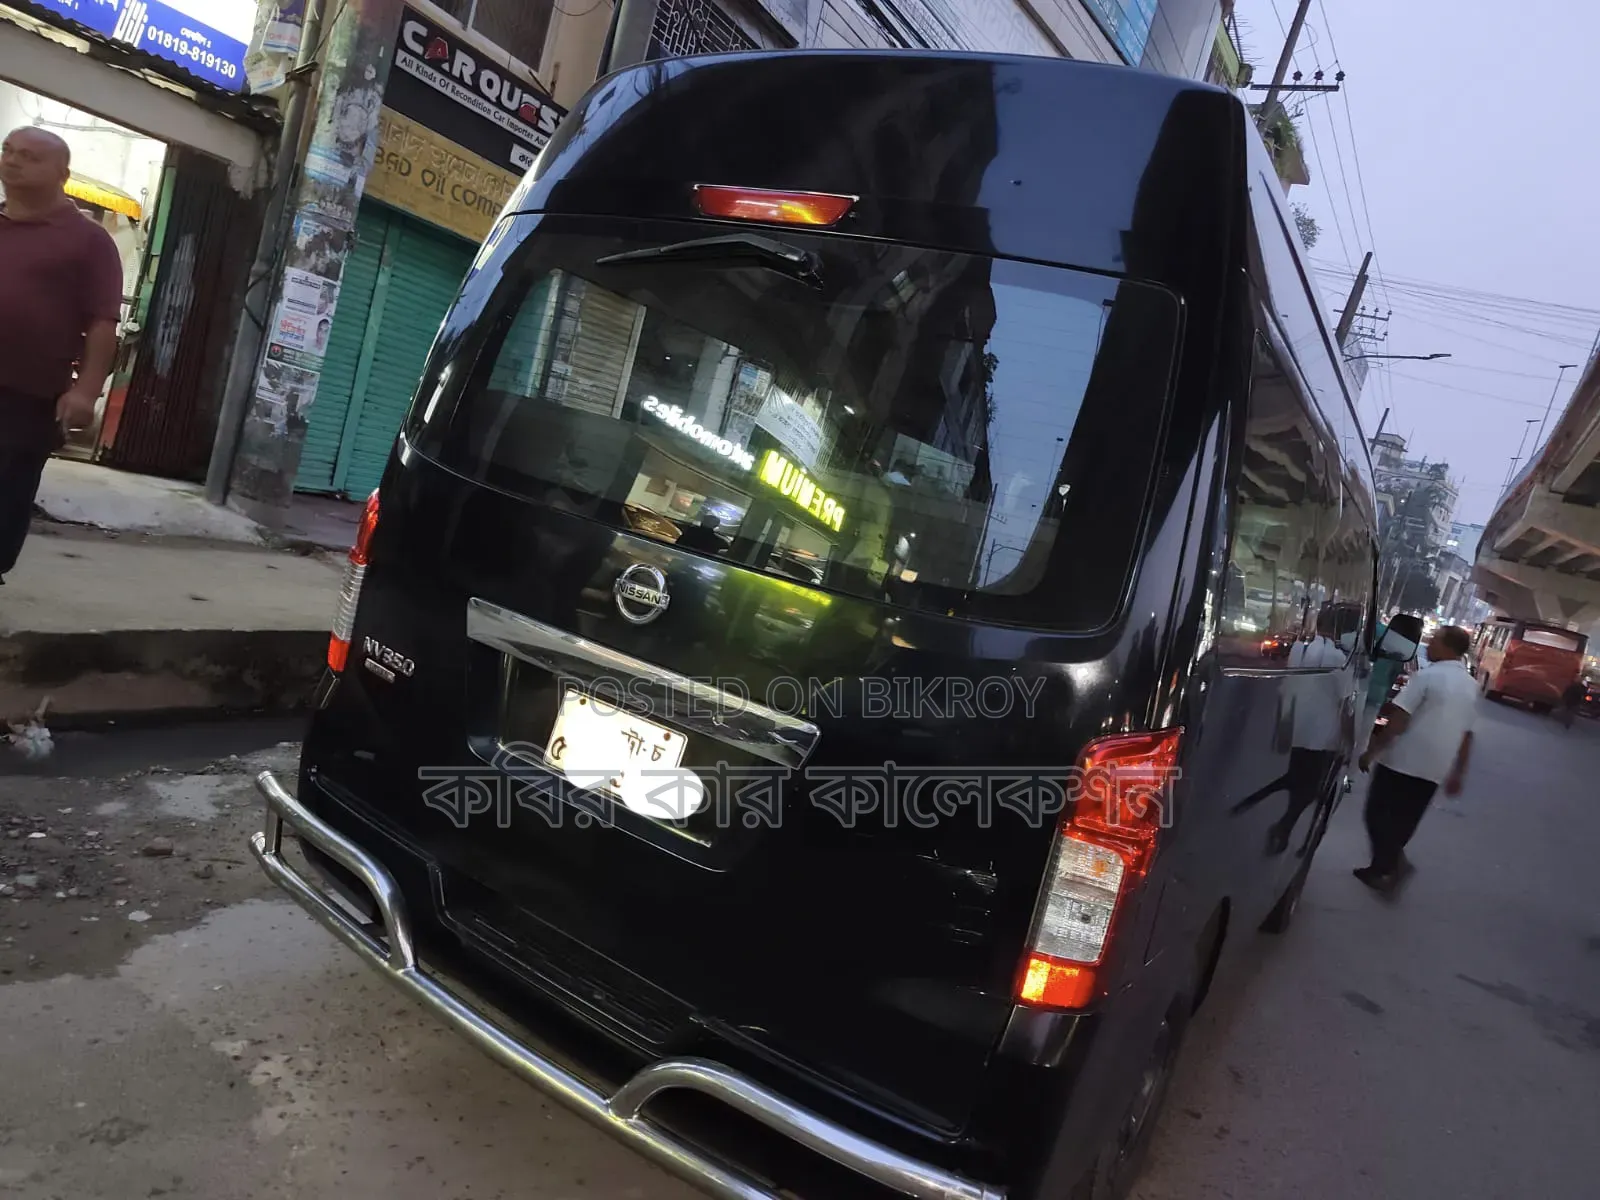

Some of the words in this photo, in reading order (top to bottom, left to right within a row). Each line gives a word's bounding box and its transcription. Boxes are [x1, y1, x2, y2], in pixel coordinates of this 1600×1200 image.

[147, 25, 236, 78] 01819-819130
[401, 56, 413, 69] All
[415, 62, 436, 83] Kinds
[439, 78, 450, 91] Of
[451, 85, 492, 116] Recondition
[494, 111, 505, 123] Car
[507, 118, 533, 139] Importer
[620, 582, 661, 605] NISSAN
[363, 636, 415, 677] NV350
